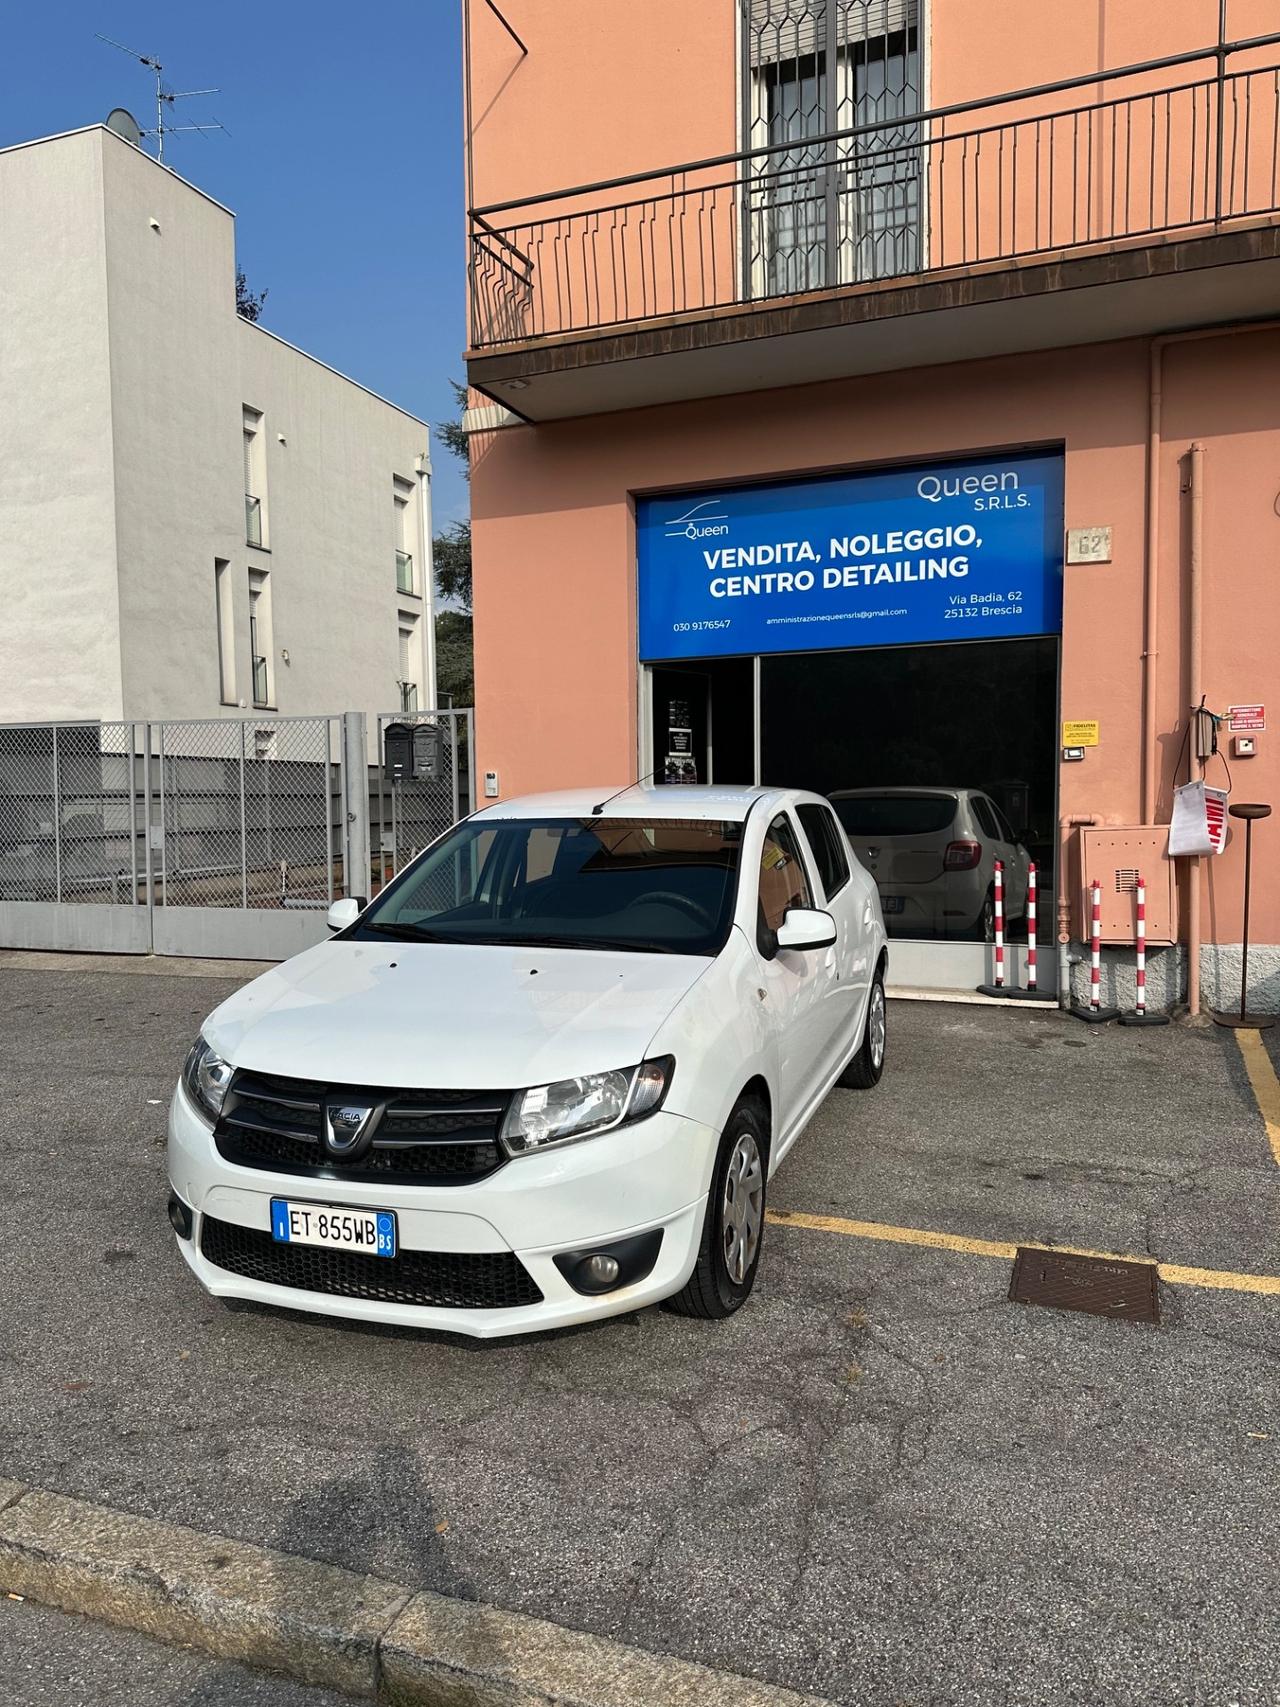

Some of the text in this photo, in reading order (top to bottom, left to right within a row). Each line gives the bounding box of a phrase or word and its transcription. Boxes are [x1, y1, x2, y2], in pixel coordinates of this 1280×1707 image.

[917, 471, 1020, 503] Queen
[974, 493, 1031, 512] S.R.L.S.
[685, 522, 729, 540] Queen
[703, 525, 983, 570] VENDITA, NOLEGGIO,
[709, 555, 969, 598] CENTRO DETAILING
[949, 590, 1023, 605] Via Badia, 62
[766, 609, 908, 625] amministrazionequeensrls@gmail.com
[944, 604, 1023, 618] 25132 Brescia
[673, 619, 731, 632] 030 9176547
[290, 1211, 311, 1236] ET
[319, 1215, 376, 1245] 855WB
[378, 1234, 392, 1250] BS
